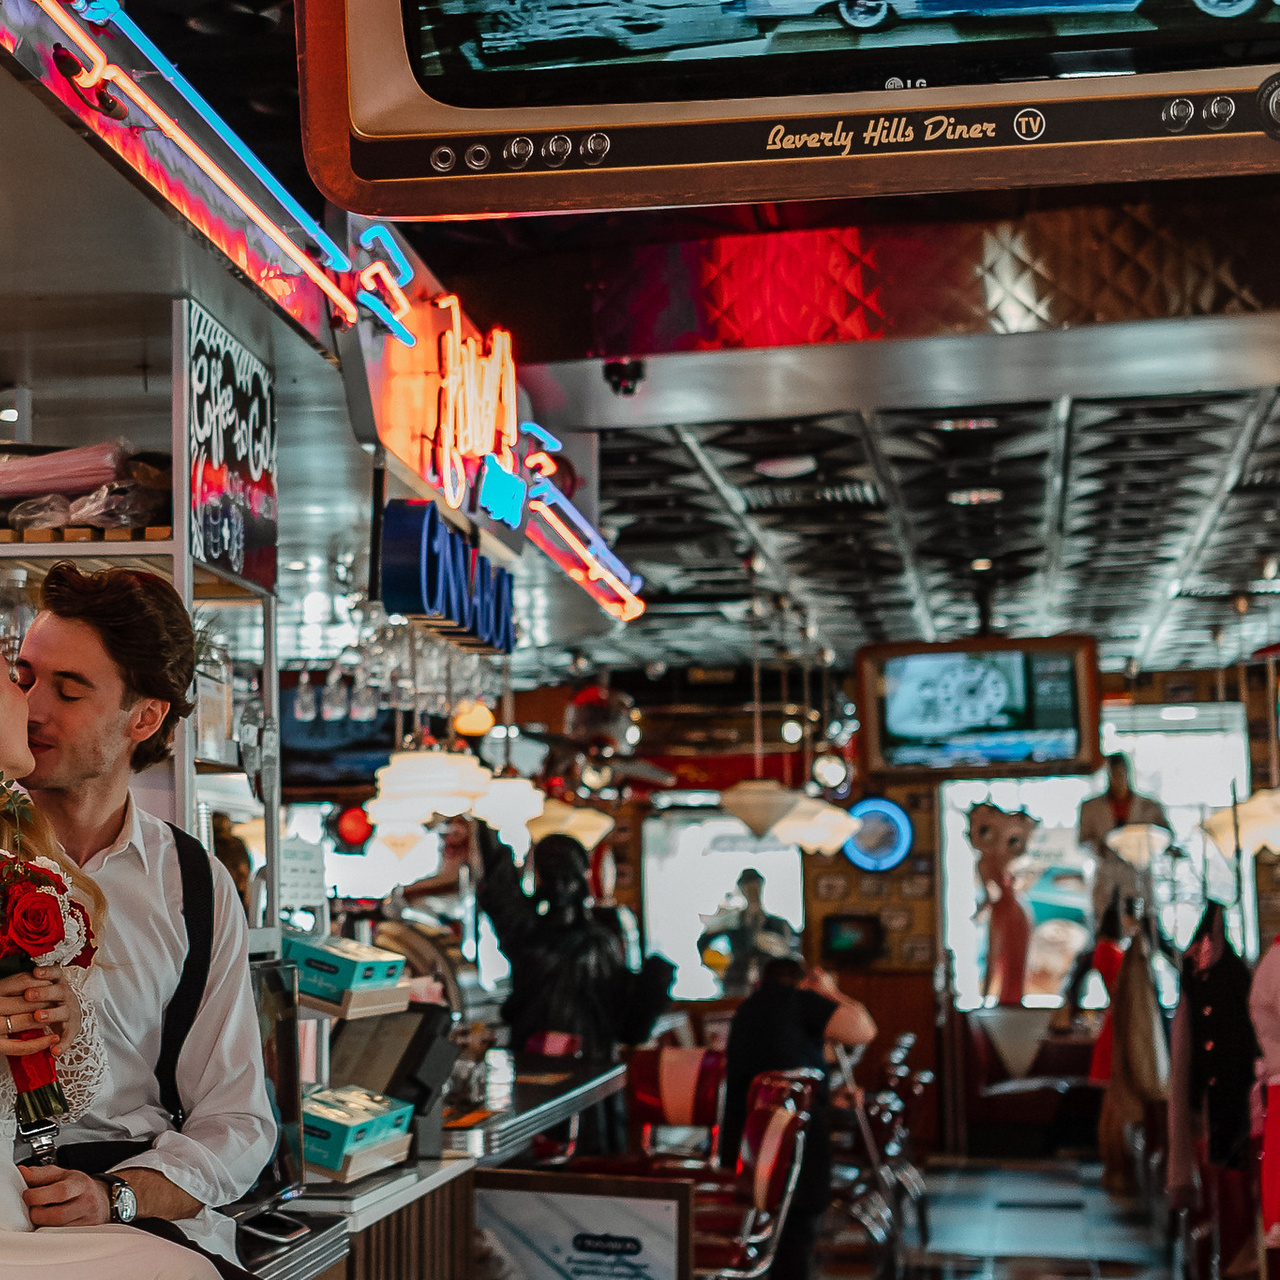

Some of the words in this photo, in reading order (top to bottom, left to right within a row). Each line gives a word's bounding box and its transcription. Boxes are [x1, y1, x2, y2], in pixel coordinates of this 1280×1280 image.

[766, 120, 854, 157] Beverly
[863, 117, 914, 147] Hills
[924, 115, 996, 141] Diner
[1018, 116, 1041, 134] TV
[191, 354, 237, 471] Coffee
